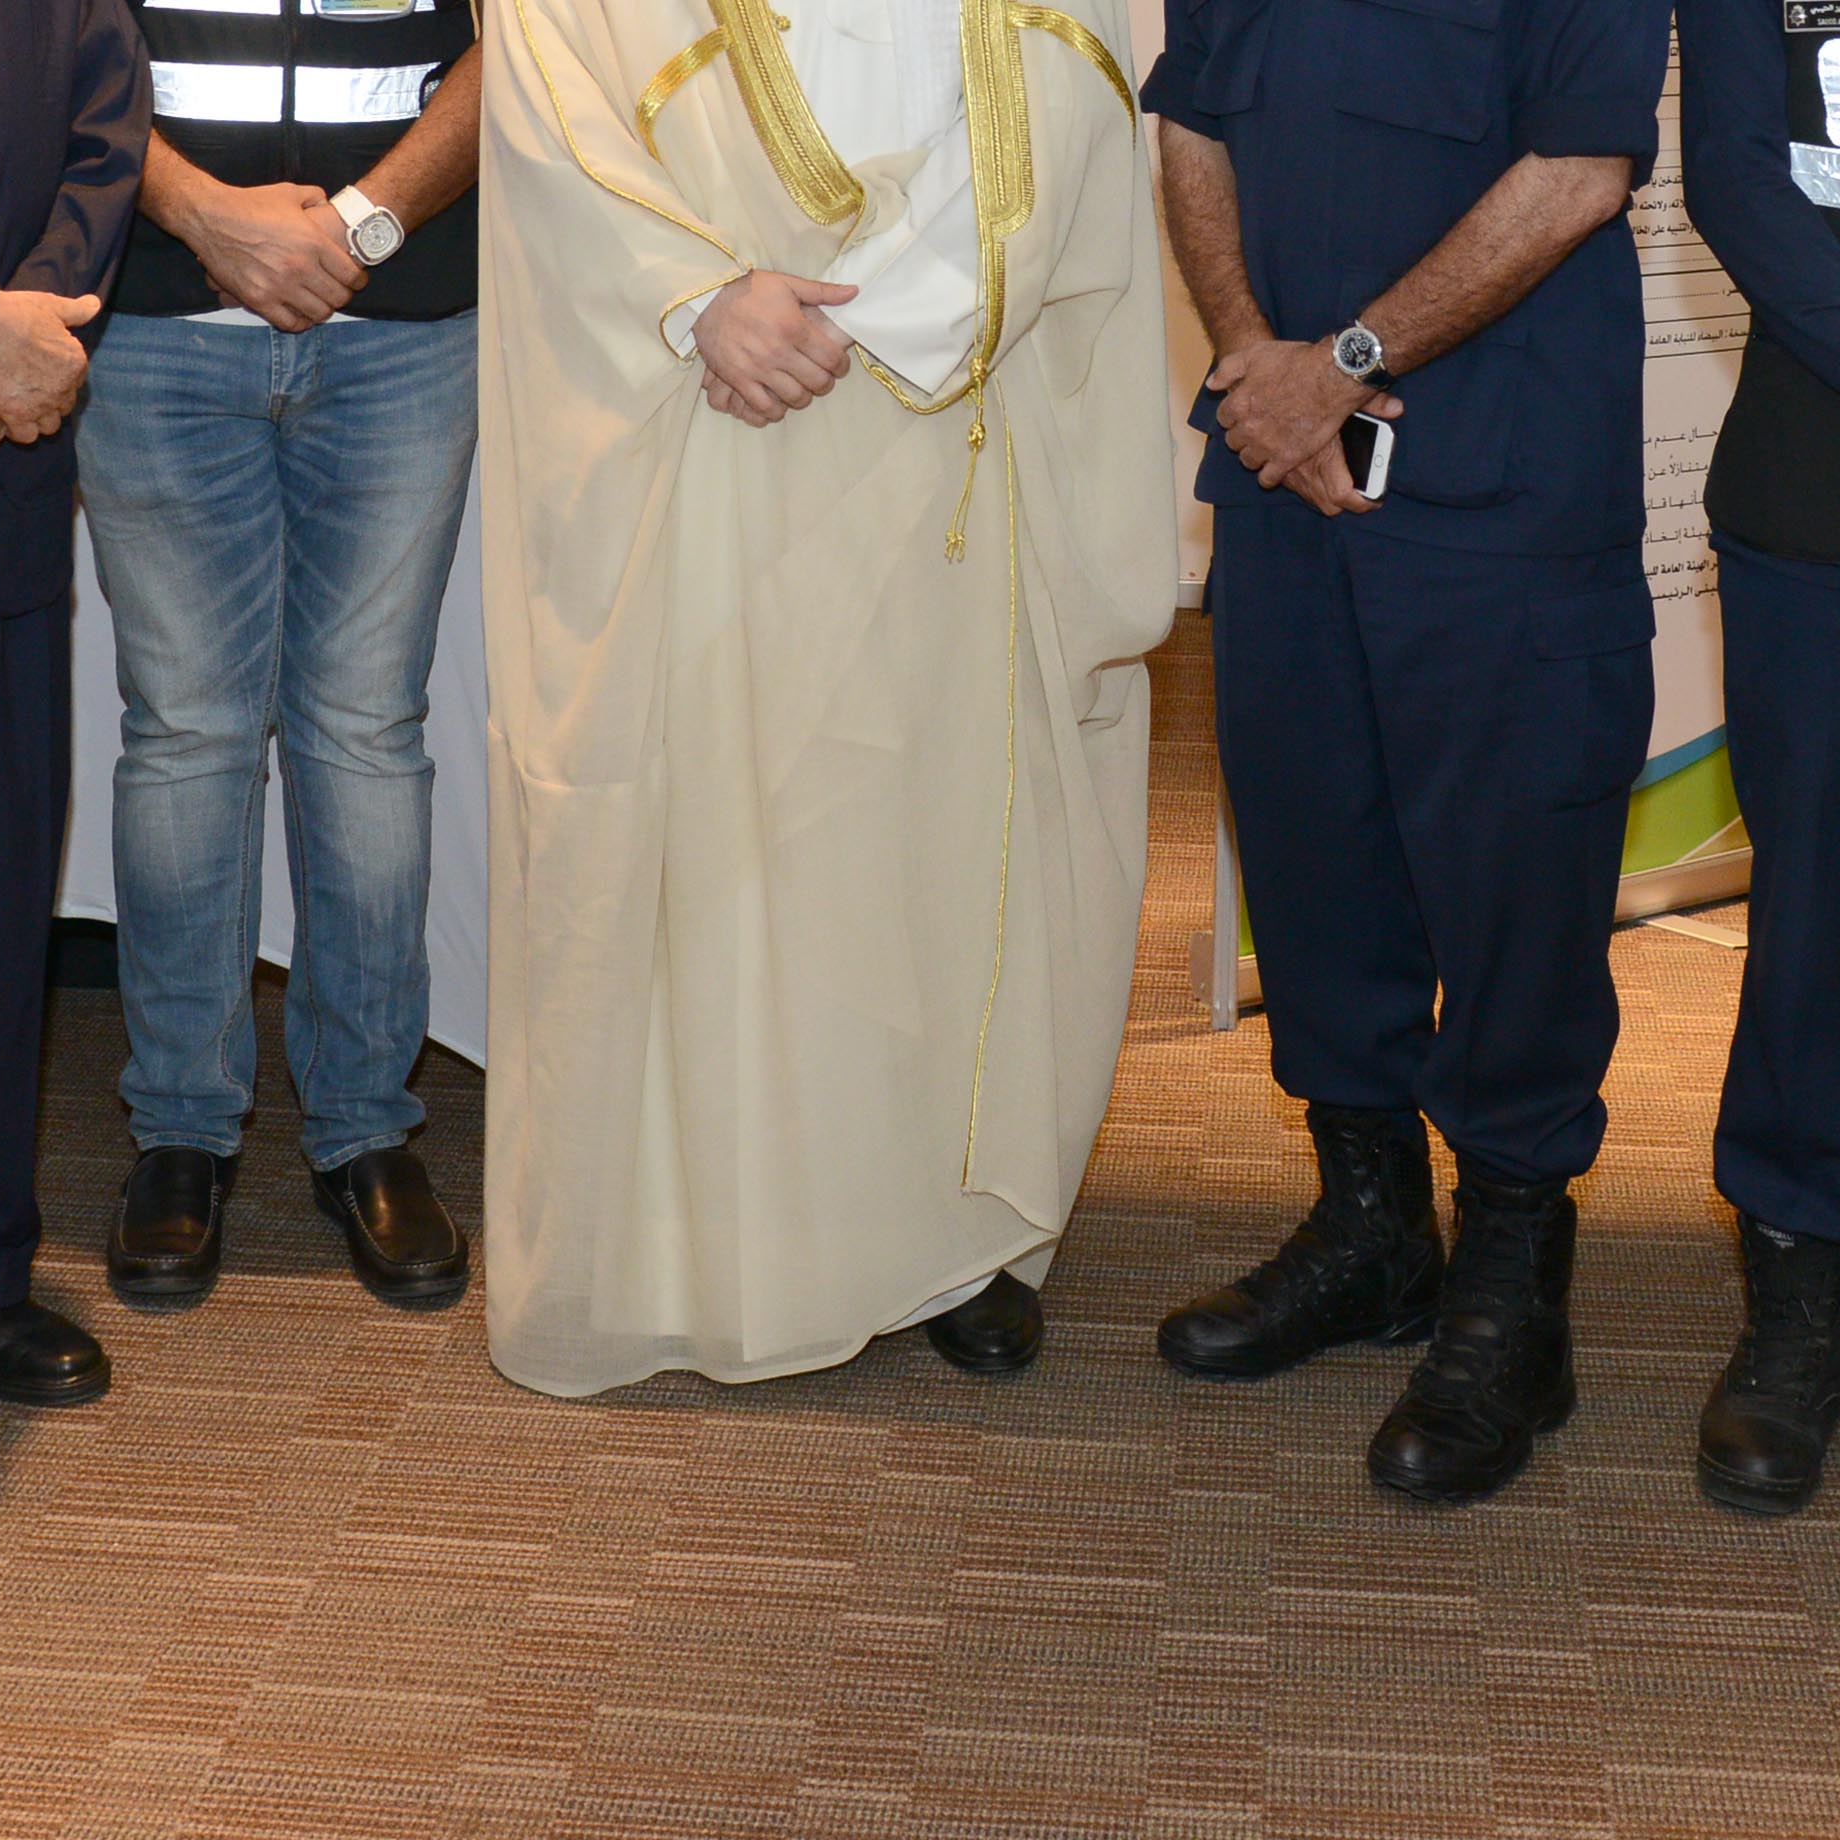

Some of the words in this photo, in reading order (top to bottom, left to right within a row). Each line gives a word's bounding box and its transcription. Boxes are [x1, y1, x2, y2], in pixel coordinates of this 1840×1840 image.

[1654, 433, 1686, 449] عدم
[1648, 467, 1667, 481] عن
[1668, 490, 1704, 510] أنها
